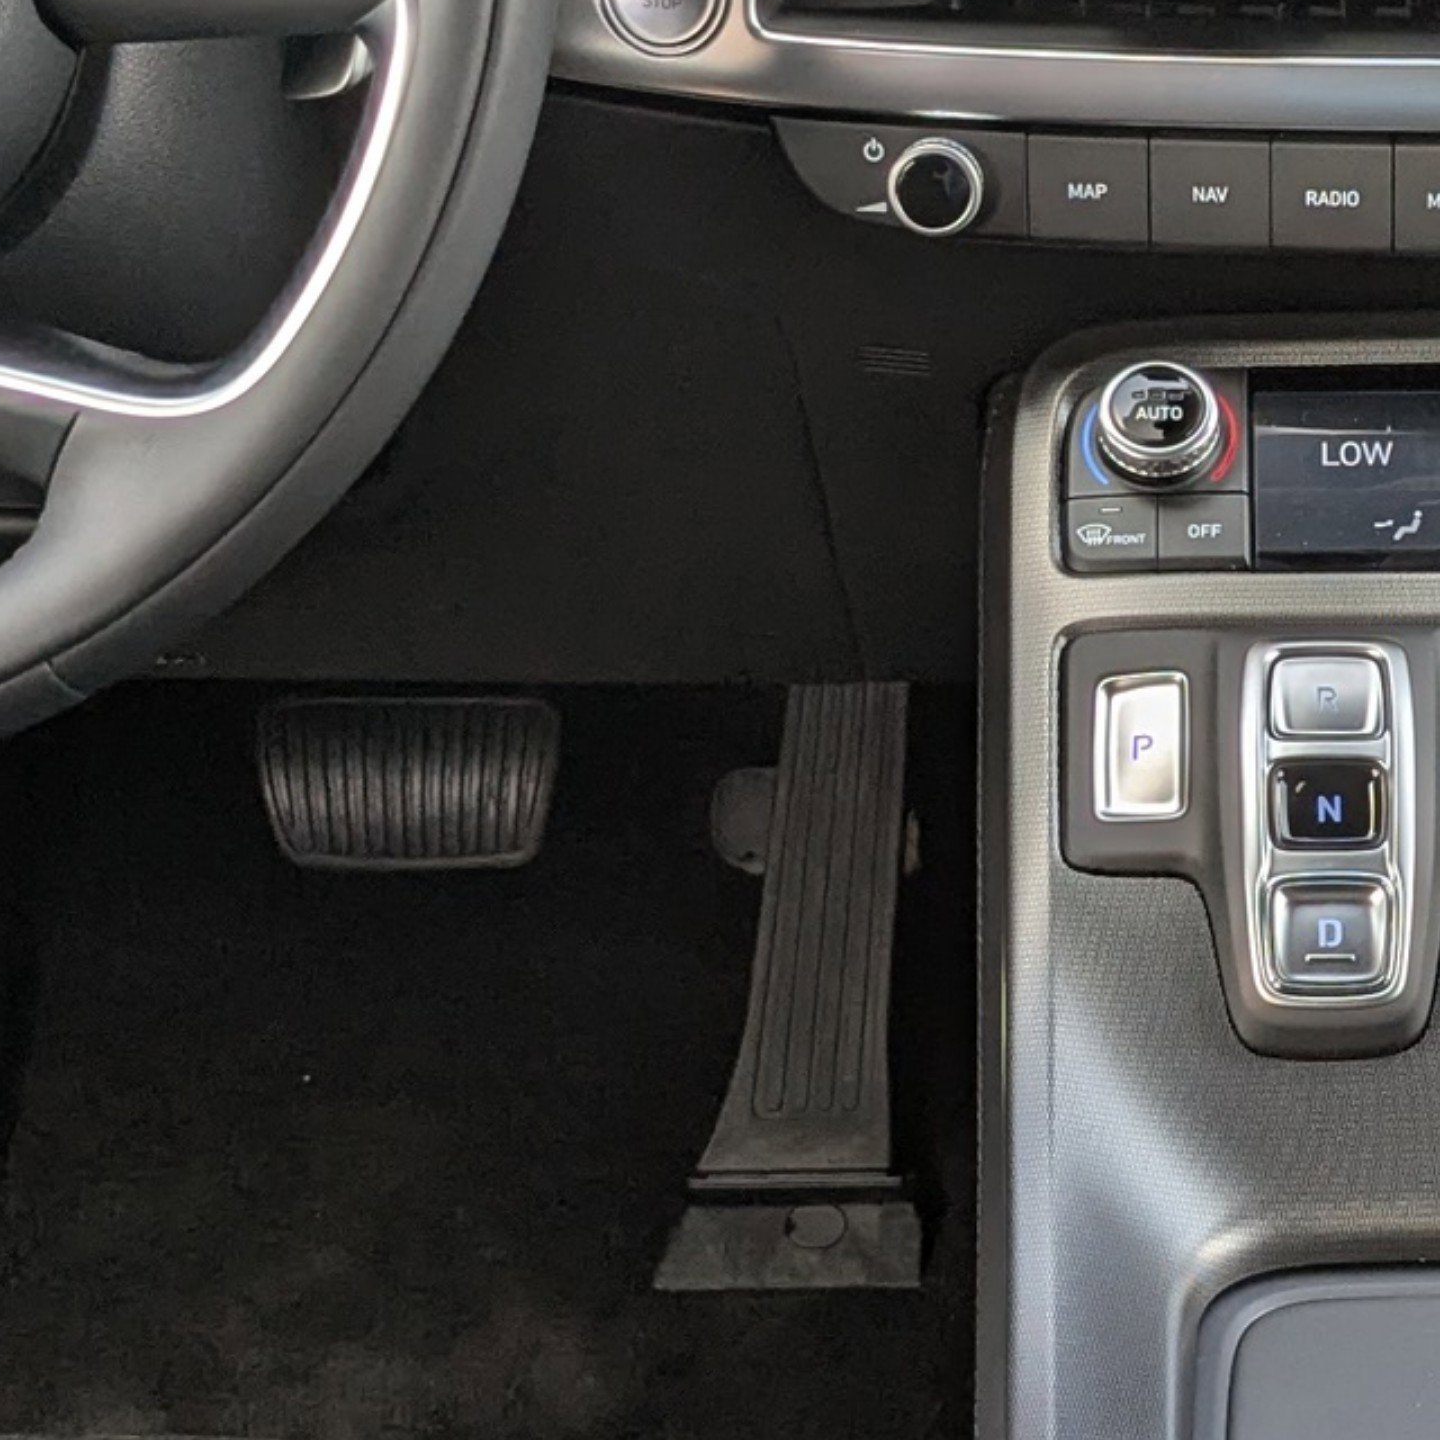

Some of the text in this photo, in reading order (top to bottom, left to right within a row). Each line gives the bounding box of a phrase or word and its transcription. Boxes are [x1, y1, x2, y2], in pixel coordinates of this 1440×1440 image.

[1068, 183, 1107, 201] MAP
[1192, 186, 1229, 204] NAV
[1304, 190, 1360, 208] RADIO
[1135, 407, 1183, 422] AUTO
[1321, 441, 1393, 467] LOW
[1107, 533, 1146, 545] FRONT
[1188, 524, 1222, 539] OFF
[1316, 686, 1339, 713] R
[1133, 734, 1154, 761] P
[1317, 796, 1342, 823] N
[1317, 918, 1343, 947] D
